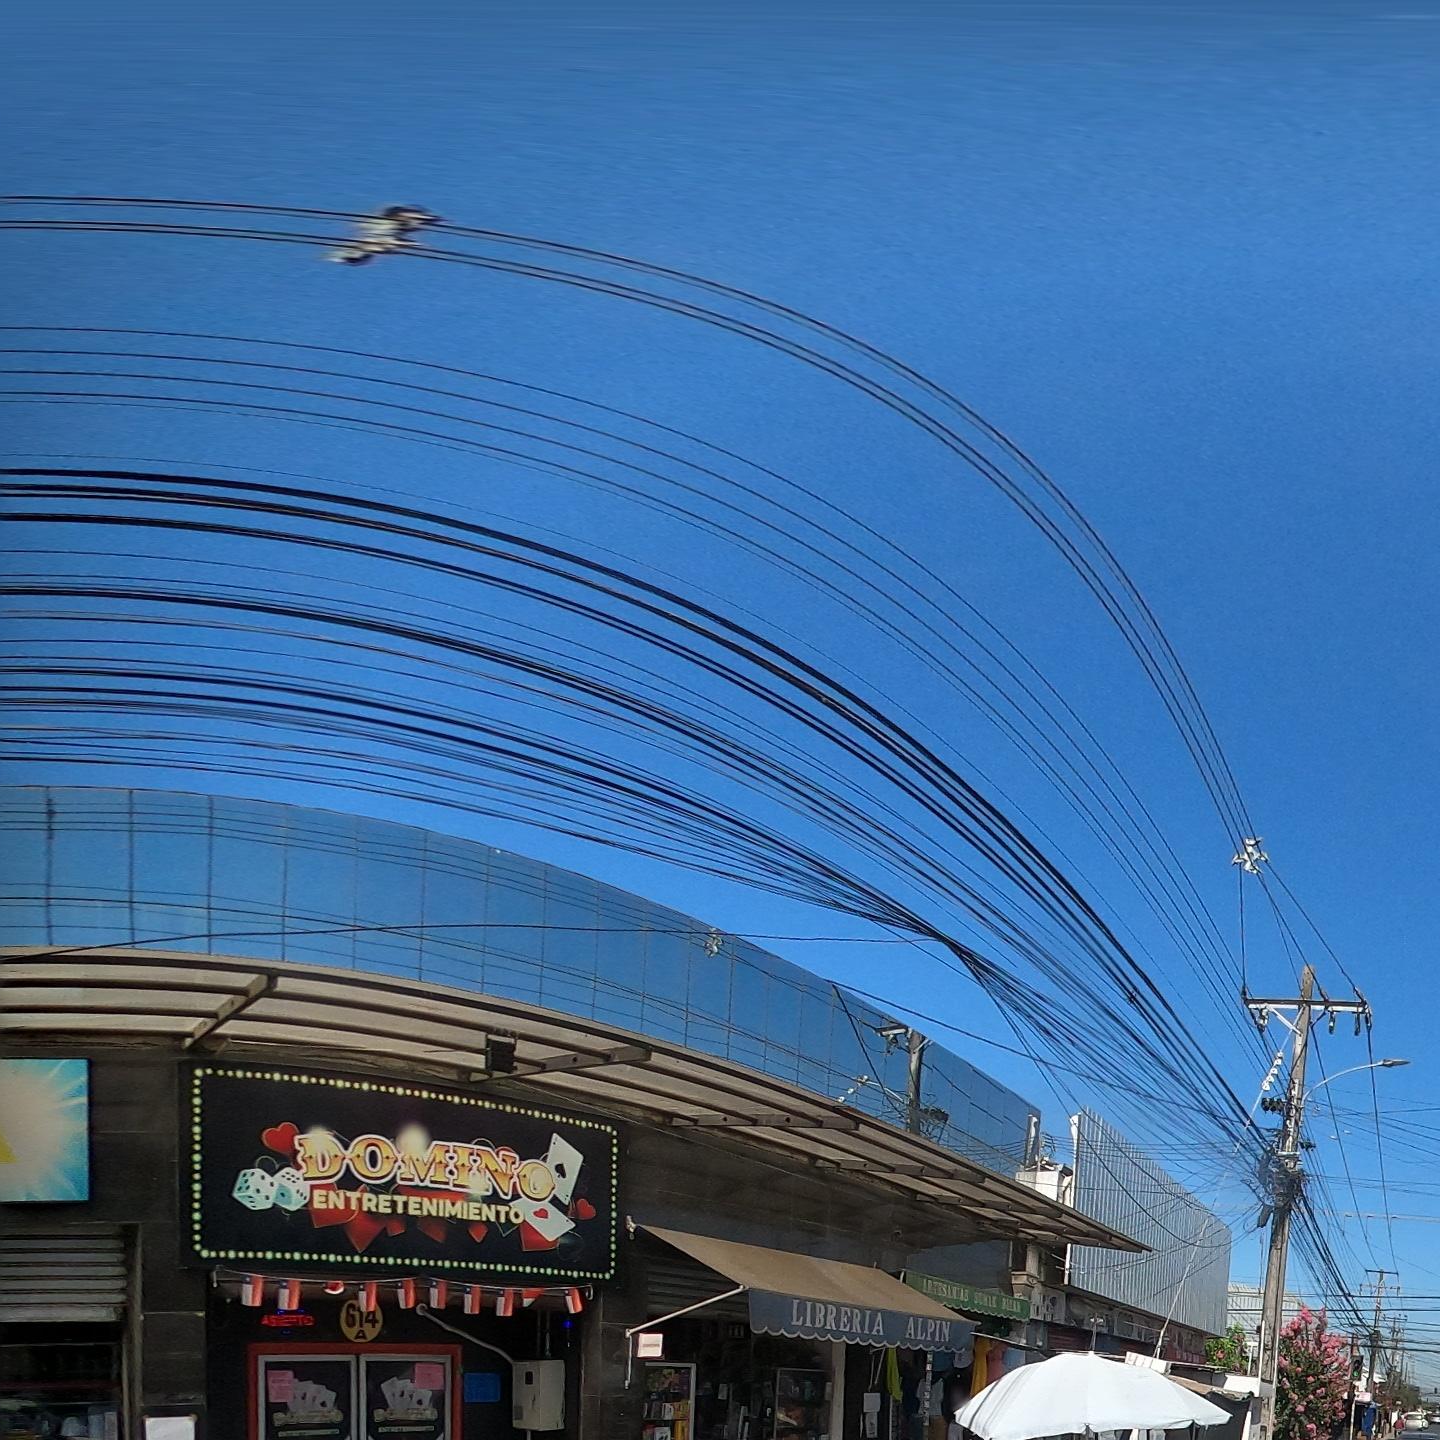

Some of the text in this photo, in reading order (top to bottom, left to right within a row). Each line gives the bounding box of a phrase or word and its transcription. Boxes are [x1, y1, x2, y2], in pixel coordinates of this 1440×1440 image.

[295, 1132, 556, 1201] DOMINO
[313, 1189, 525, 1224] ENTRETENIMIENTO
[346, 1303, 379, 1328] 614
[791, 1300, 951, 1342] LIBRERIA ALPIN
[354, 1330, 367, 1340] A
